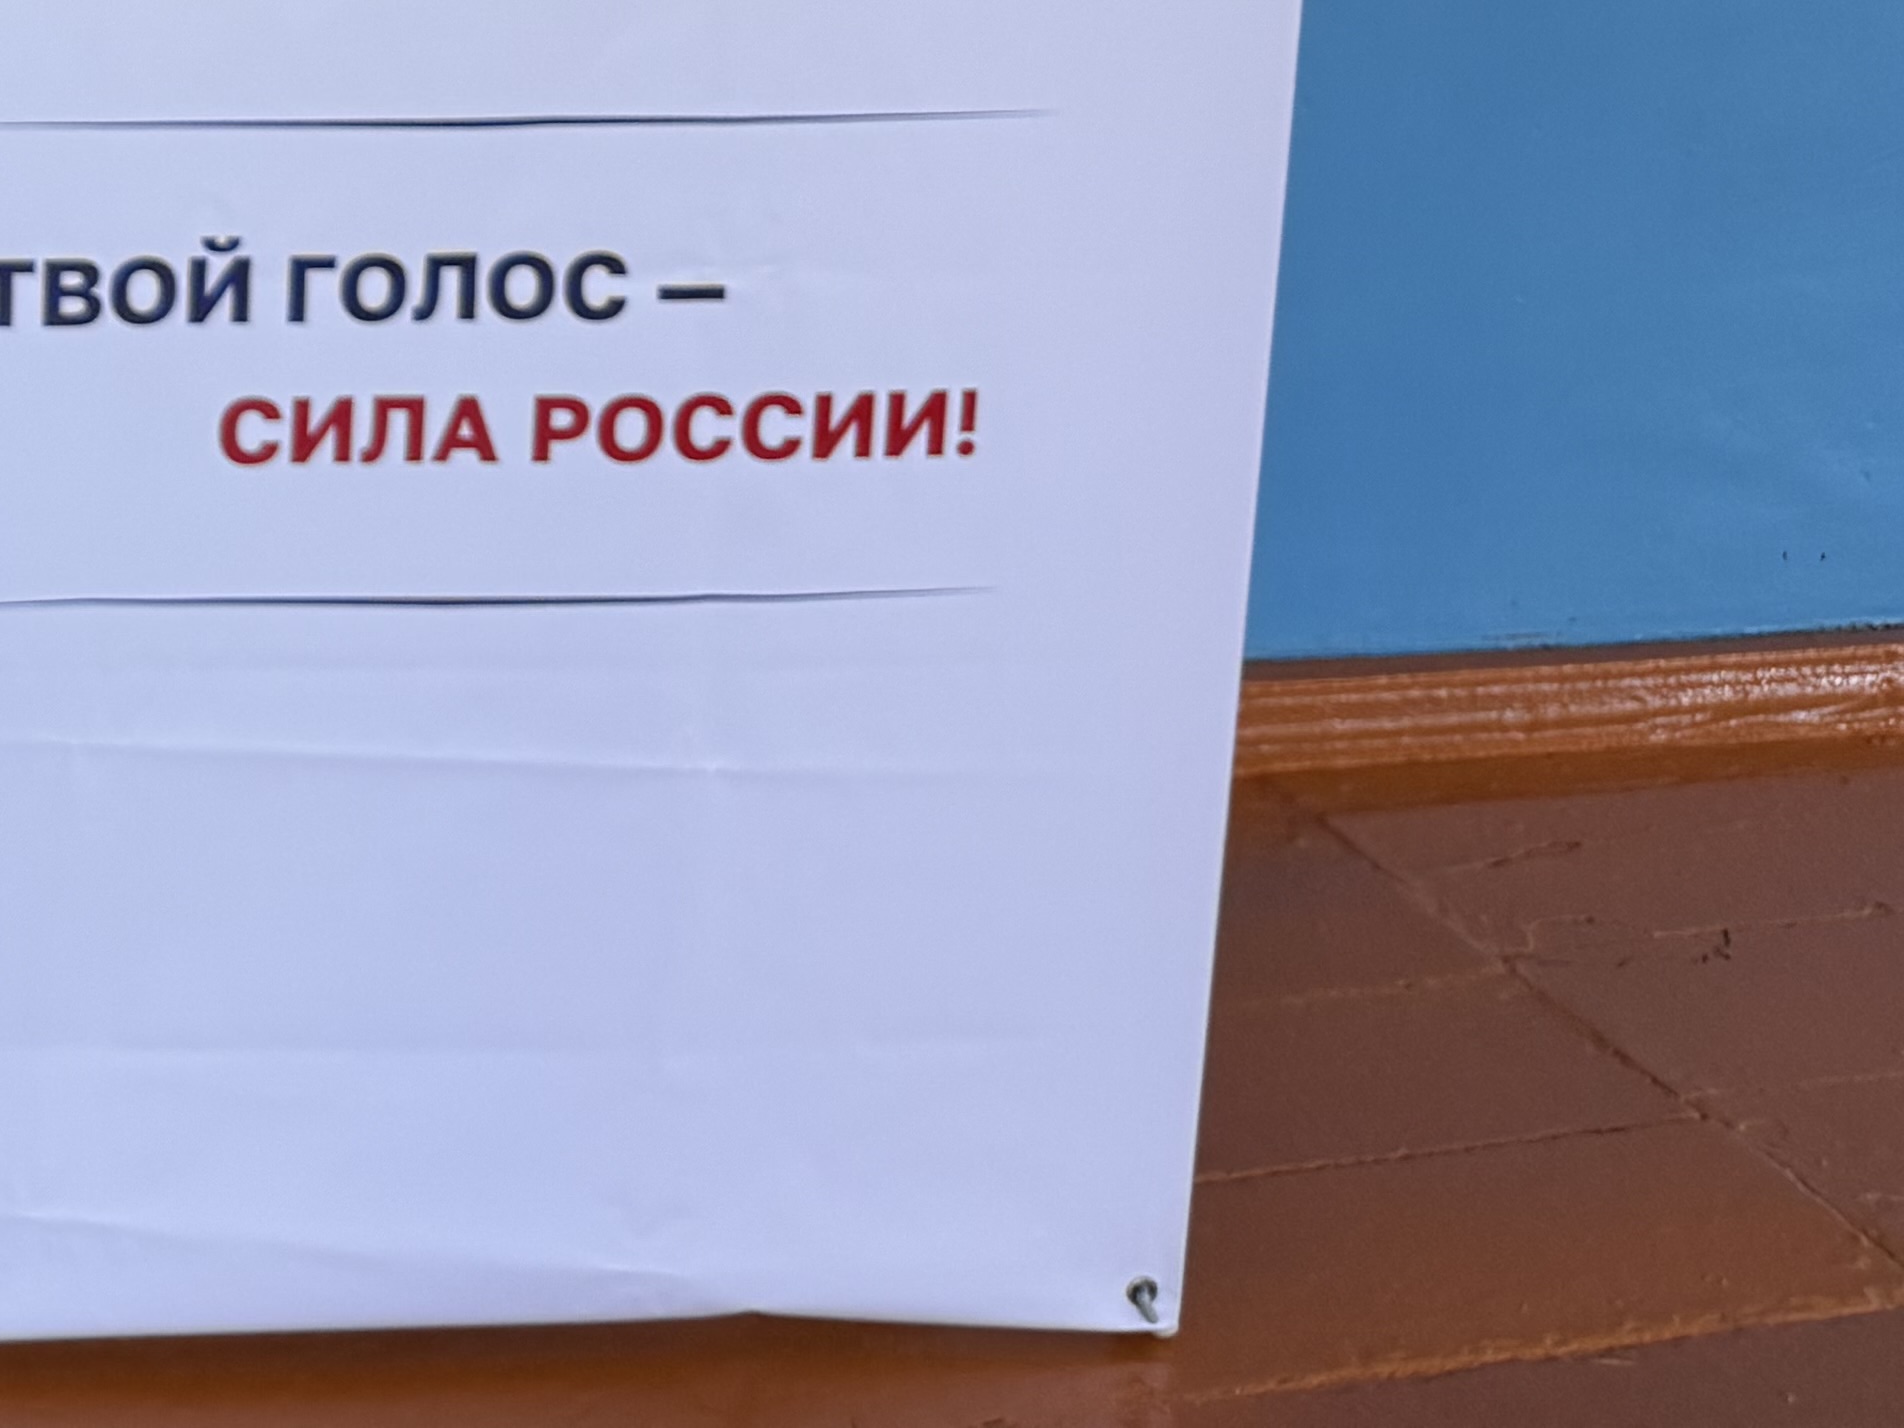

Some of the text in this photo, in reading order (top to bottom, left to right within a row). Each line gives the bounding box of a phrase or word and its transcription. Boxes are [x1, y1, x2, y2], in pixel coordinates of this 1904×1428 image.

[287, 252, 628, 324] ГОЛОС
[220, 389, 979, 467] СИЛА РОССИИ!
